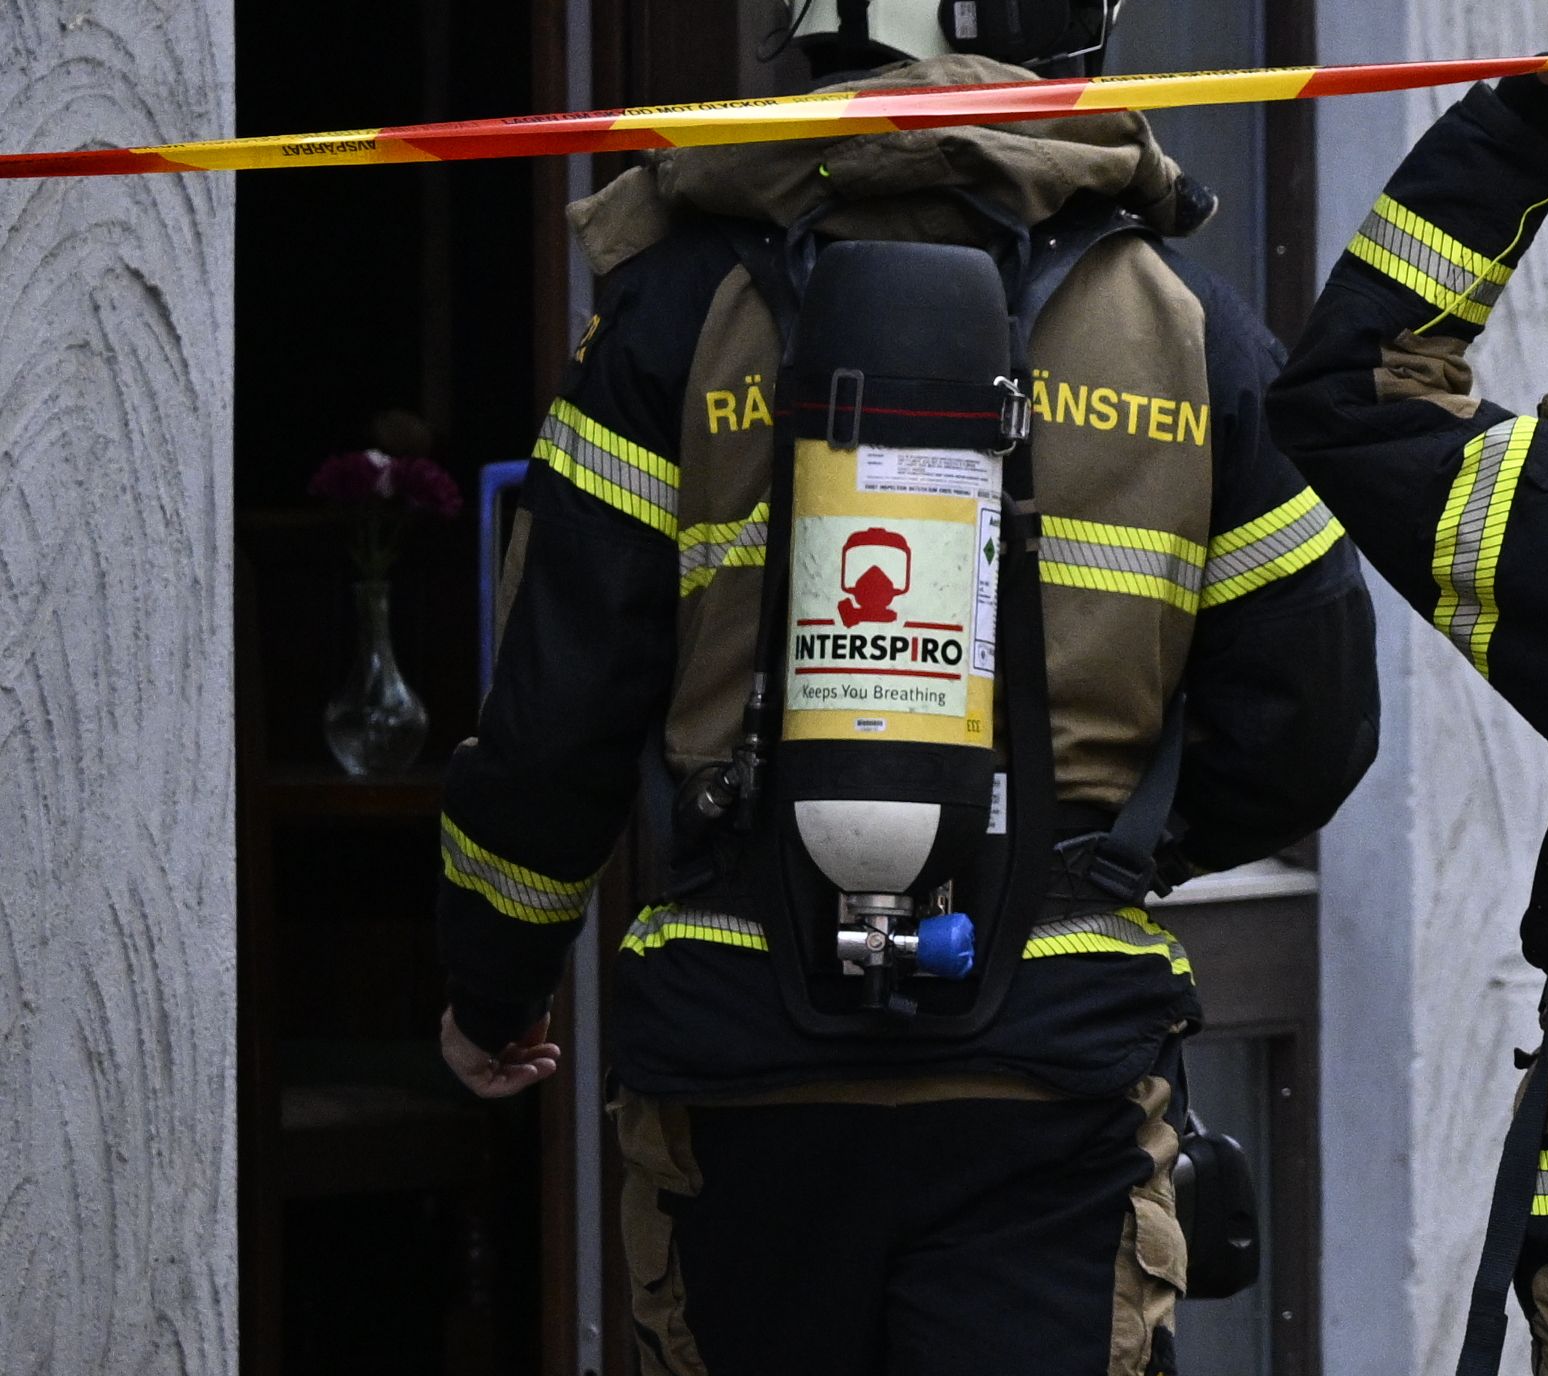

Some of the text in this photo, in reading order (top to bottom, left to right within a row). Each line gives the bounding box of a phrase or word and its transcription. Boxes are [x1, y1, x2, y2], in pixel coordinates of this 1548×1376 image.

[706, 375, 773, 435] RÄ
[795, 634, 963, 666] INTERSPIRO
[802, 684, 946, 706] Keeps You Breathing
